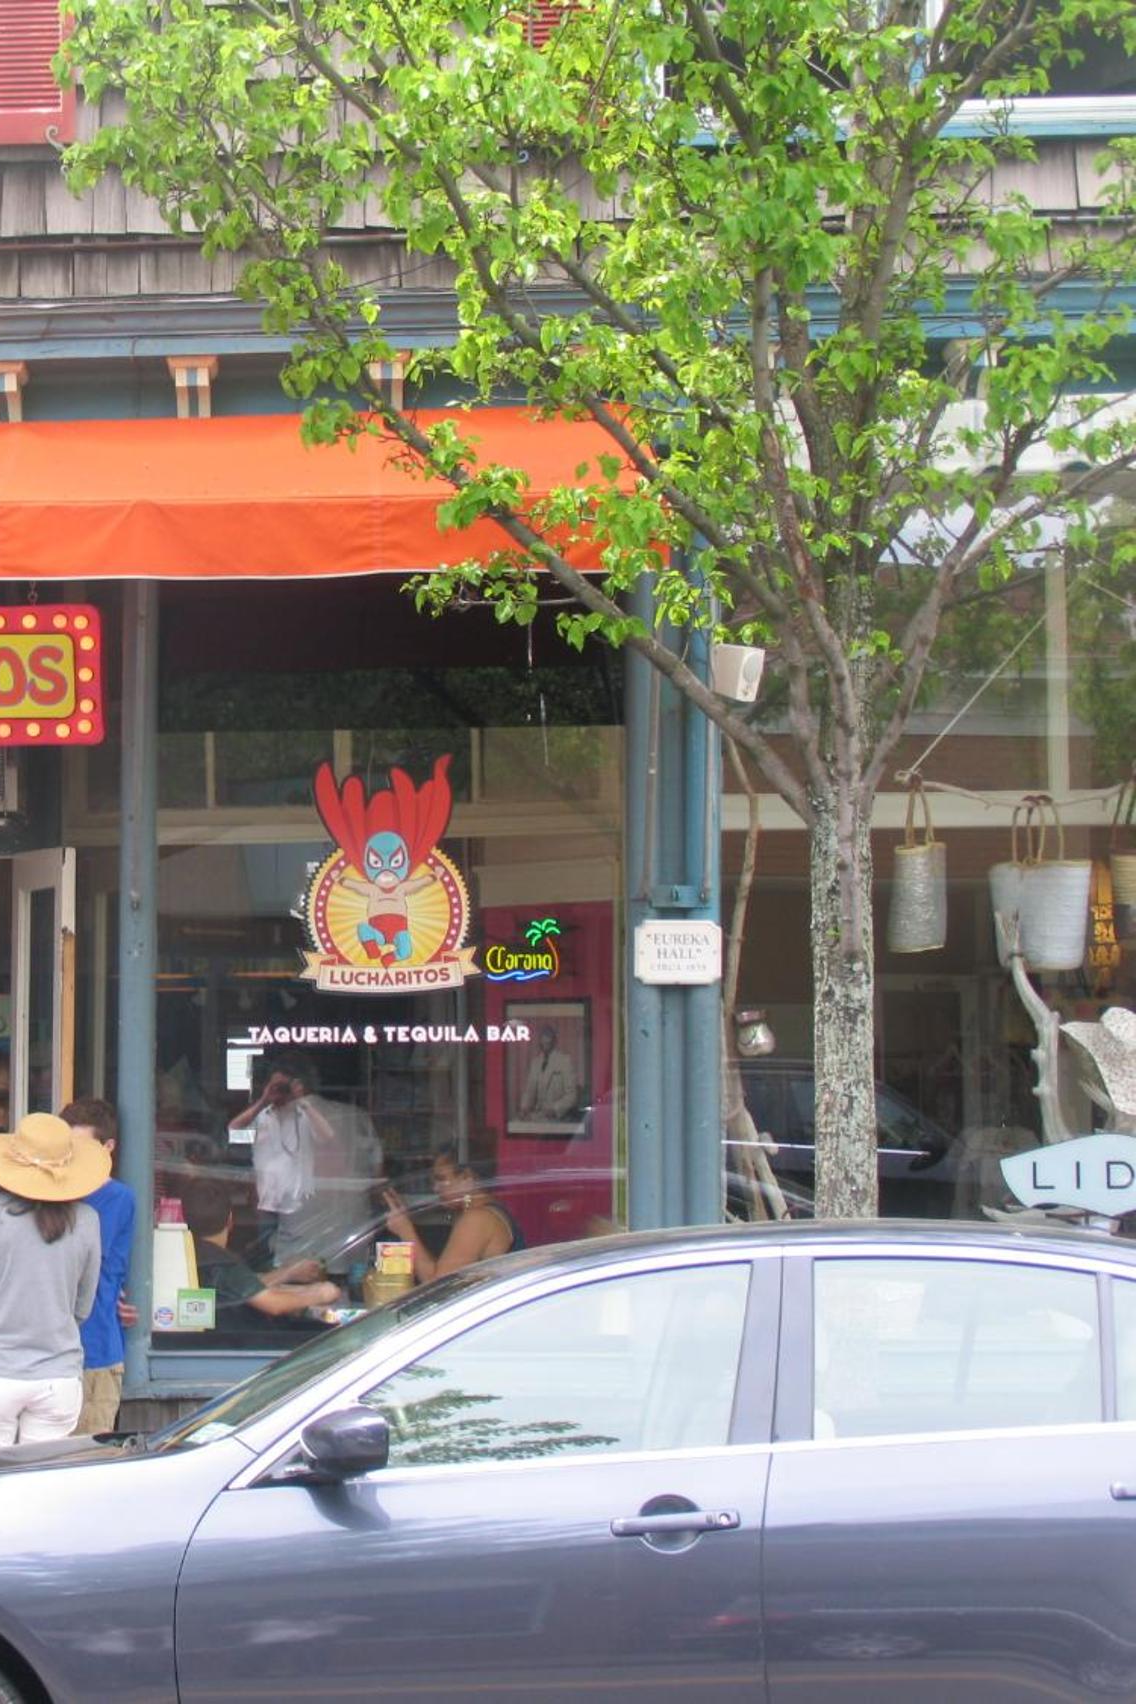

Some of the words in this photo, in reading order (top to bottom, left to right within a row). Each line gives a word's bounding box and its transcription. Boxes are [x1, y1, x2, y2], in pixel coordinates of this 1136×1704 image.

[485, 944, 553, 974] Corona
[329, 967, 451, 988] LUCHARITOS
[247, 1024, 358, 1044] TAQUERIA
[363, 1024, 378, 1044] &
[383, 1024, 480, 1044] TEQUILA
[486, 1024, 531, 1043] BAR
